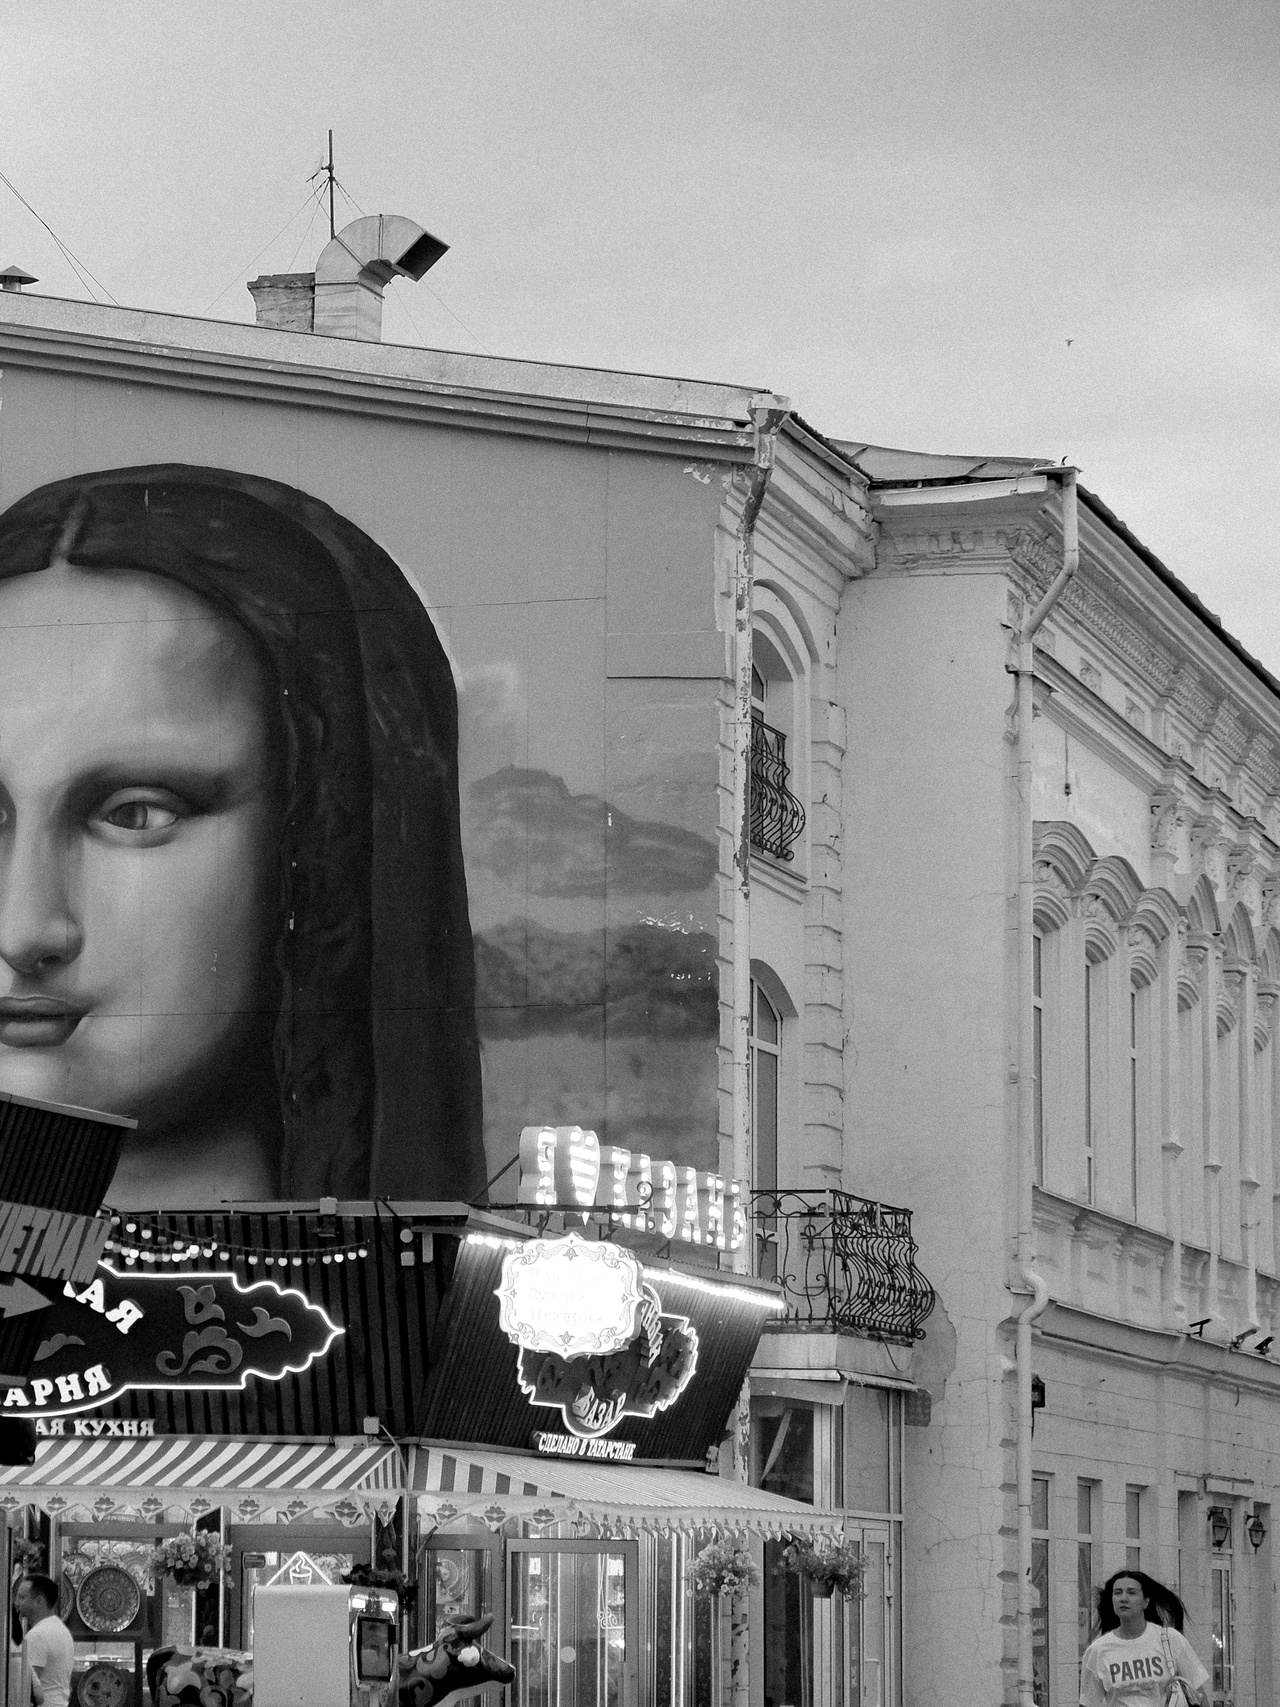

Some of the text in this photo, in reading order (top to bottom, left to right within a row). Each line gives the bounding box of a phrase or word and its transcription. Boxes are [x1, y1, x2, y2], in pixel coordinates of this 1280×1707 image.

[62, 1278, 145, 1335] АЯ
[578, 1386, 626, 1430] БАЗАР
[73, 1418, 155, 1437] КУХНЯ
[539, 1433, 636, 1460] СДЕЛАНО В ТАТАРСТАНЕ
[1109, 1656, 1164, 1683] PARIS
